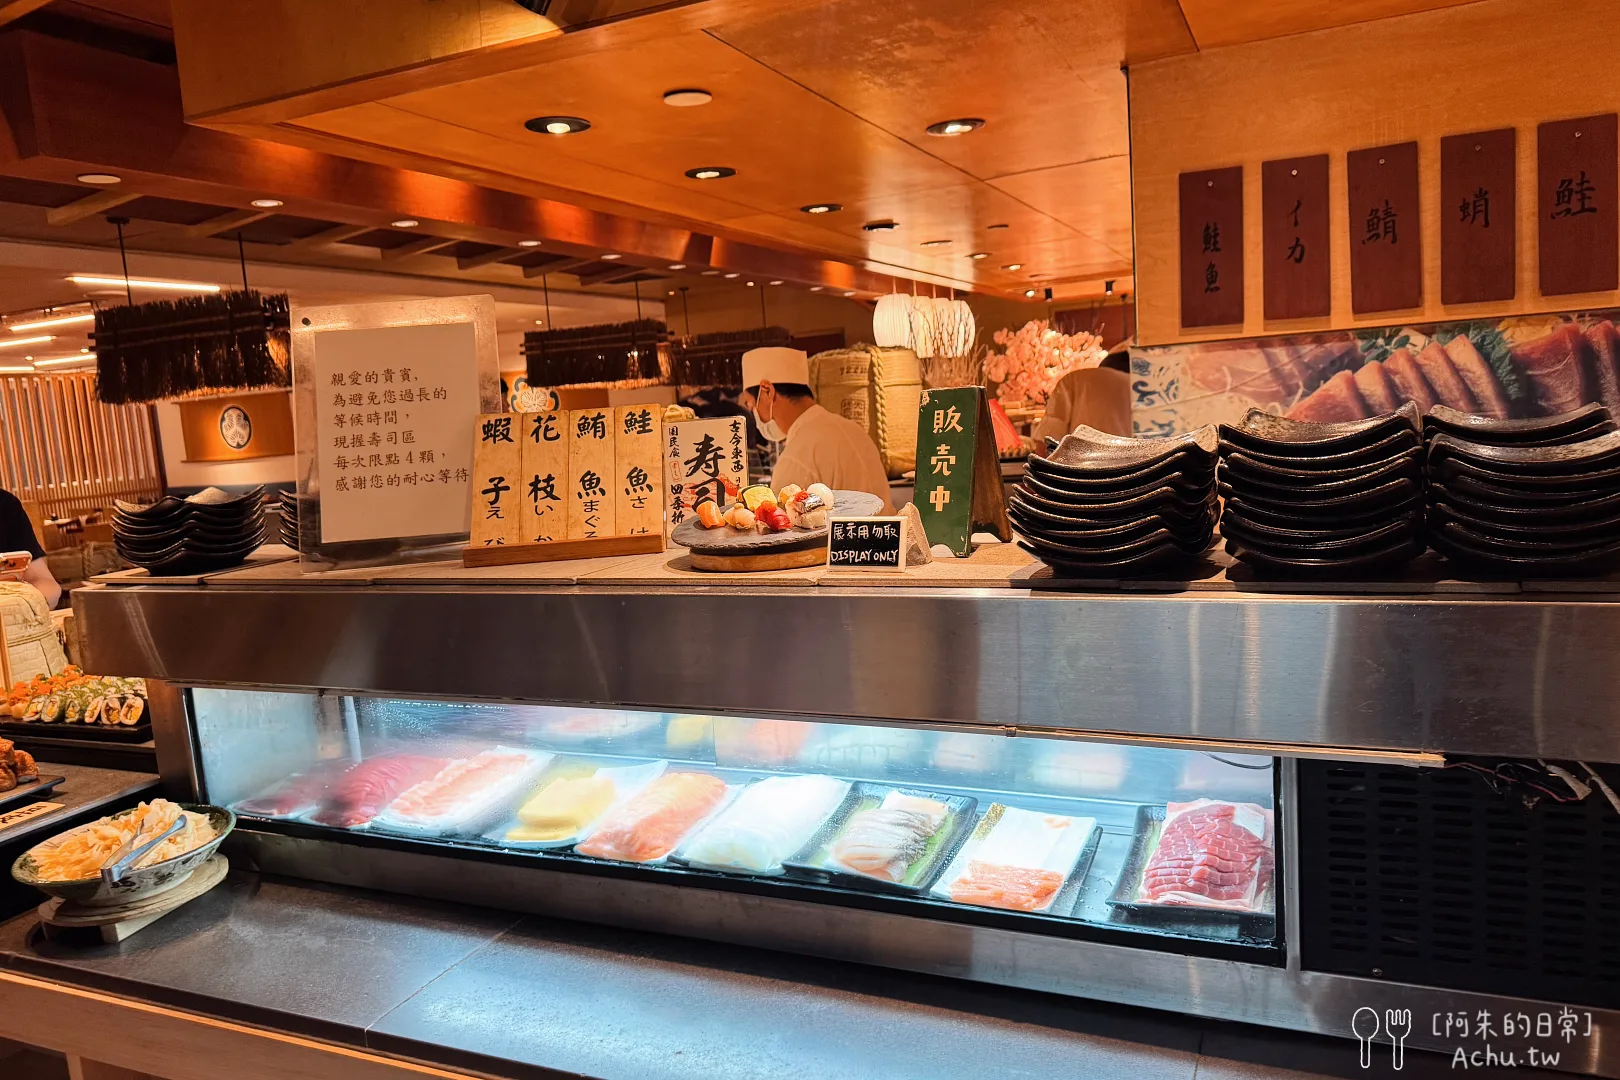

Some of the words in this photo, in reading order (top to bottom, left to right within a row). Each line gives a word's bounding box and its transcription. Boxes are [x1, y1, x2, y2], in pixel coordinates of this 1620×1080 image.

[1361, 199, 1397, 245] 鯖
[1550, 170, 1597, 220] 鮭
[1285, 198, 1305, 264] イカ
[333, 387, 447, 408] 為避免您過長的
[333, 430, 416, 448] 現握壽司區
[482, 416, 514, 505] 蝦子
[527, 414, 561, 503] 花枝
[576, 412, 606, 499] 鮪魚
[623, 409, 654, 496] 鮭魚
[929, 405, 964, 512] 販売中
[335, 467, 470, 492] 感謝您的耐心等待
[683, 433, 726, 513] 寿司
[831, 549, 873, 563] DISPLAY
[873, 549, 899, 563] ONLY
[833, 522, 899, 540] 展示用勿取
